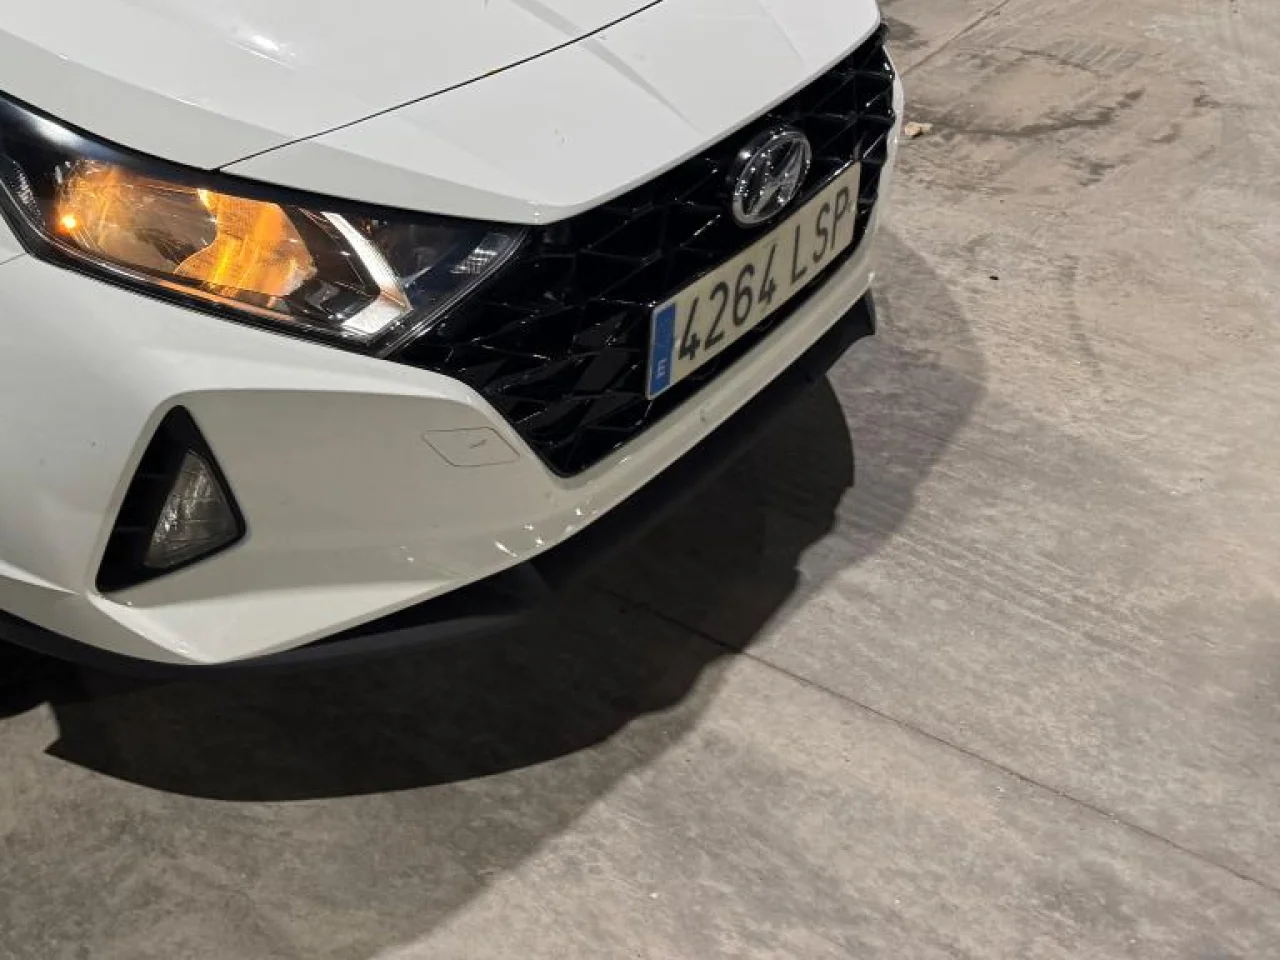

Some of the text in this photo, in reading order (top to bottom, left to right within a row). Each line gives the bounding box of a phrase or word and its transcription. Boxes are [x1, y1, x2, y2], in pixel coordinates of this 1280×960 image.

[657, 186, 849, 376] E 4264 LSP
